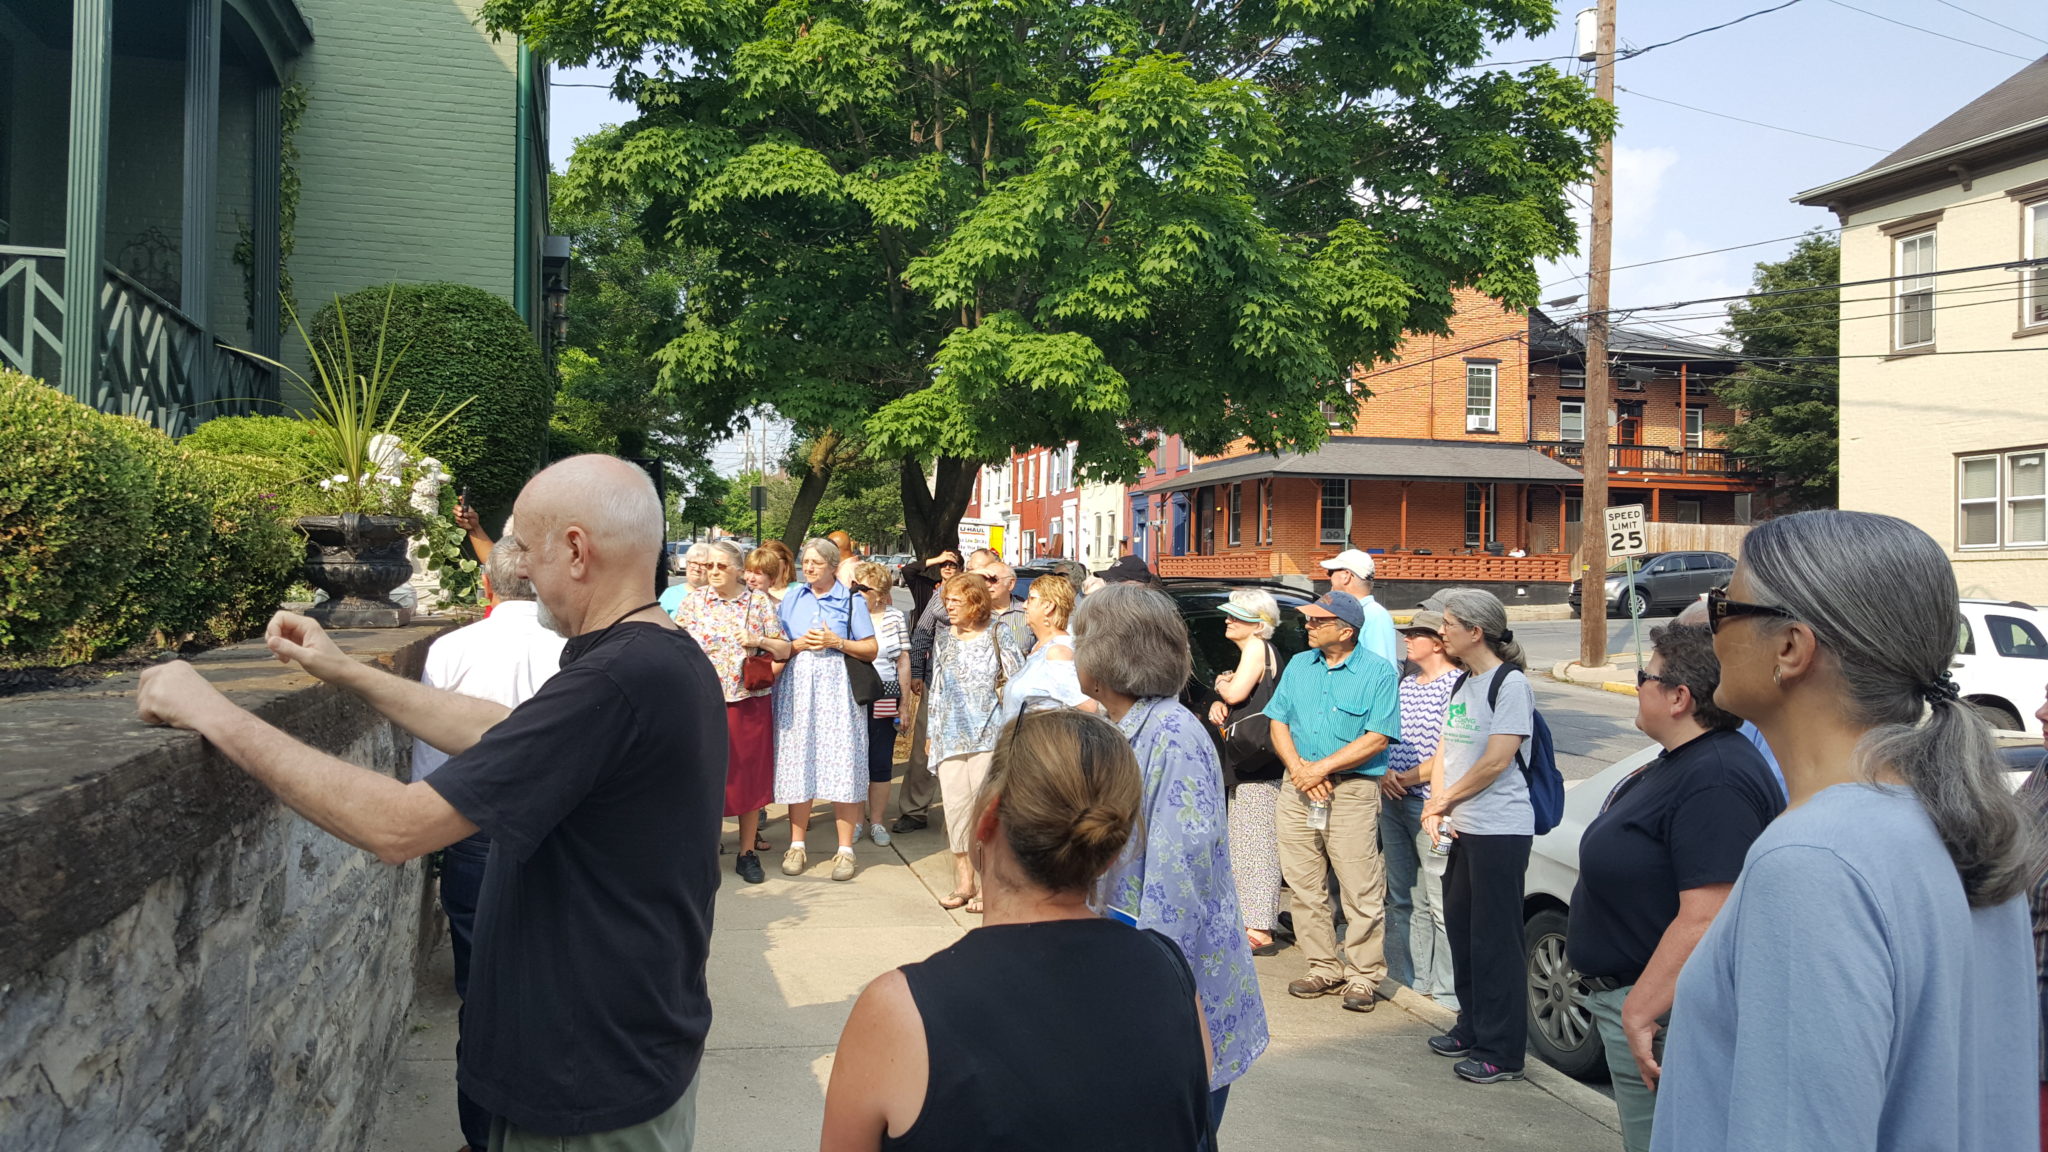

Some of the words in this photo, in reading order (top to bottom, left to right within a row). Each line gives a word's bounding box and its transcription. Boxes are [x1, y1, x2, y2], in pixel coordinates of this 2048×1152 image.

[1608, 510, 1640, 521] SPEED
[1612, 521, 1637, 531] LIMIT
[1610, 531, 1643, 551] 25
